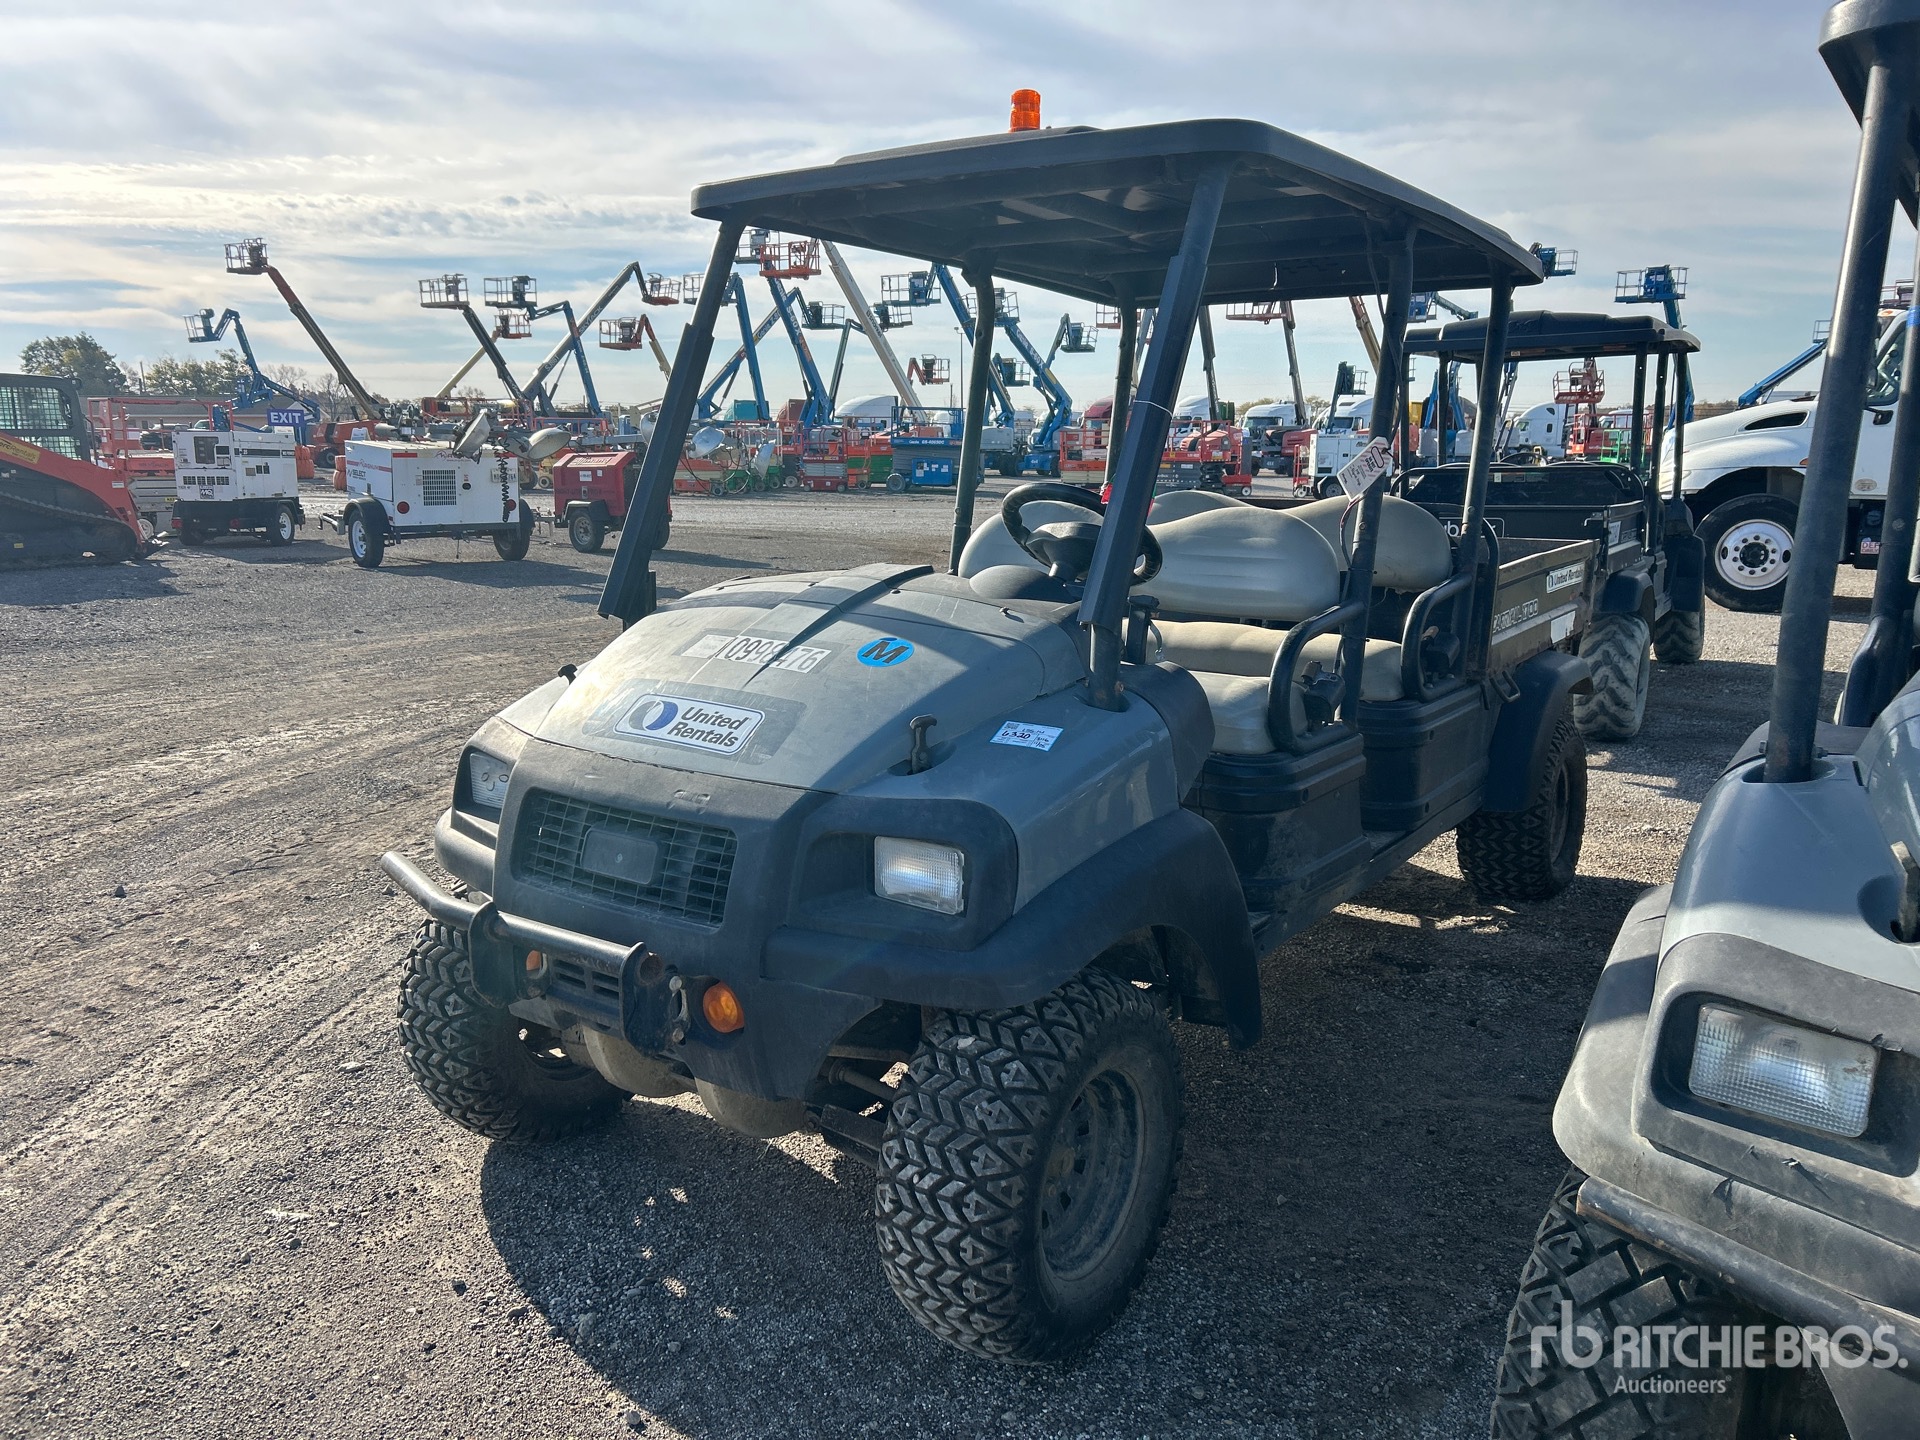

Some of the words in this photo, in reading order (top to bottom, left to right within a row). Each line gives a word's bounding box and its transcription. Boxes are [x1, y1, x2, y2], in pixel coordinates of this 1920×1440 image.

[270, 412, 302, 423] EXIT
[681, 706, 750, 731] United
[667, 721, 739, 748] Rentals
